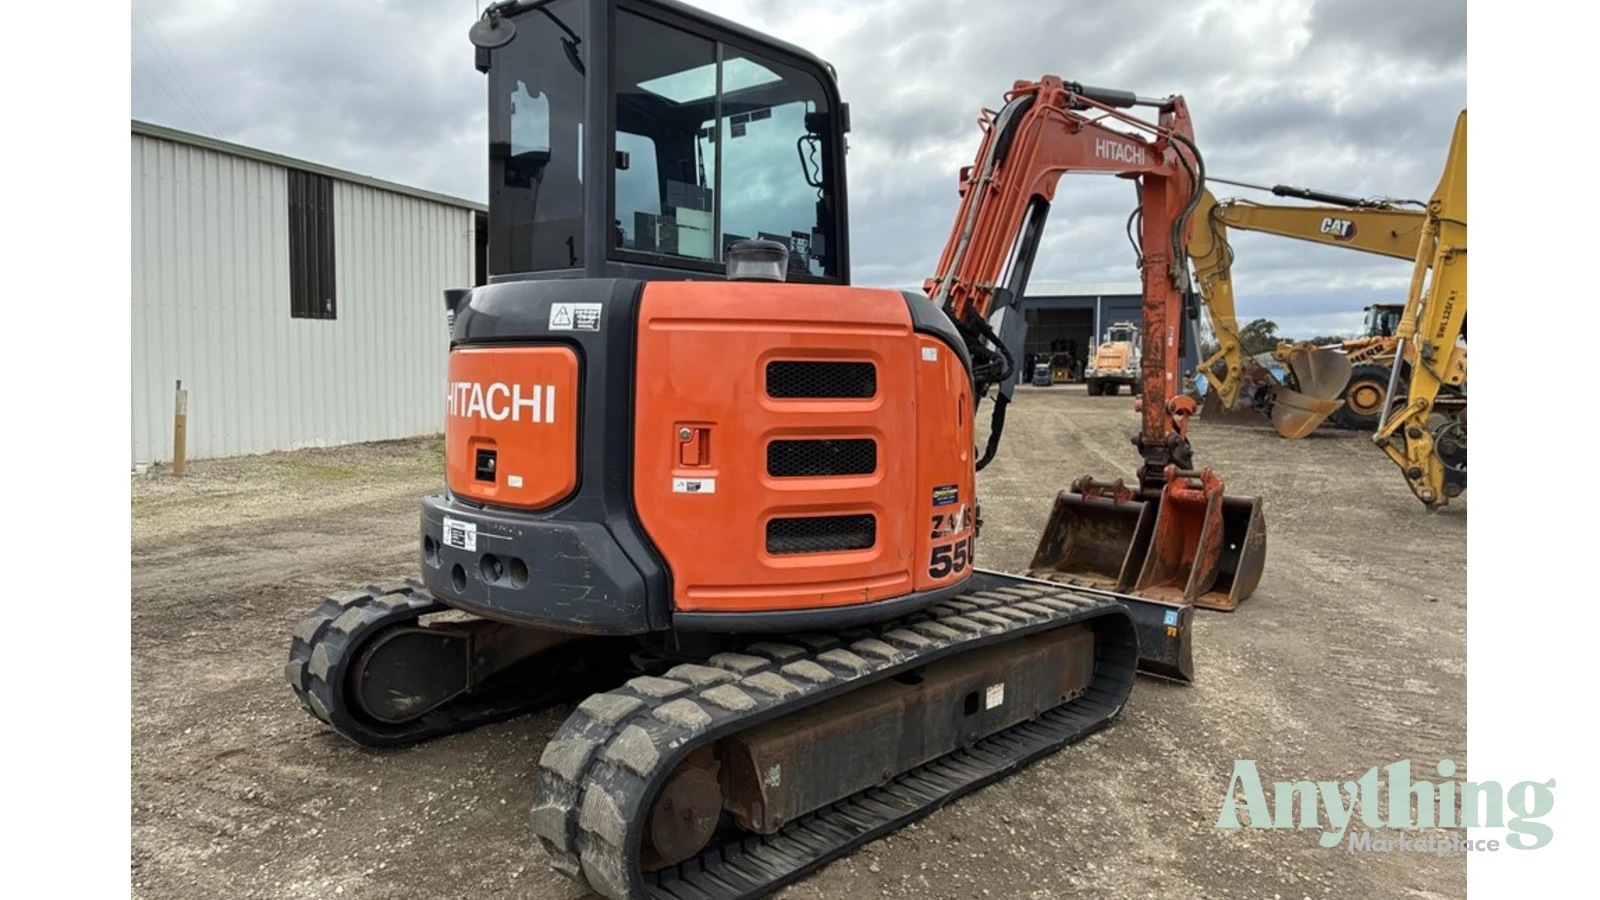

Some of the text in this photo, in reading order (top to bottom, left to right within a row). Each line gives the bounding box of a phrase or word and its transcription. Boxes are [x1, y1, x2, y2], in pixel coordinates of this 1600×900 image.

[1095, 138, 1145, 165] HITACHI
[1320, 217, 1352, 236] CAT
[446, 382, 555, 423] HITACHI
